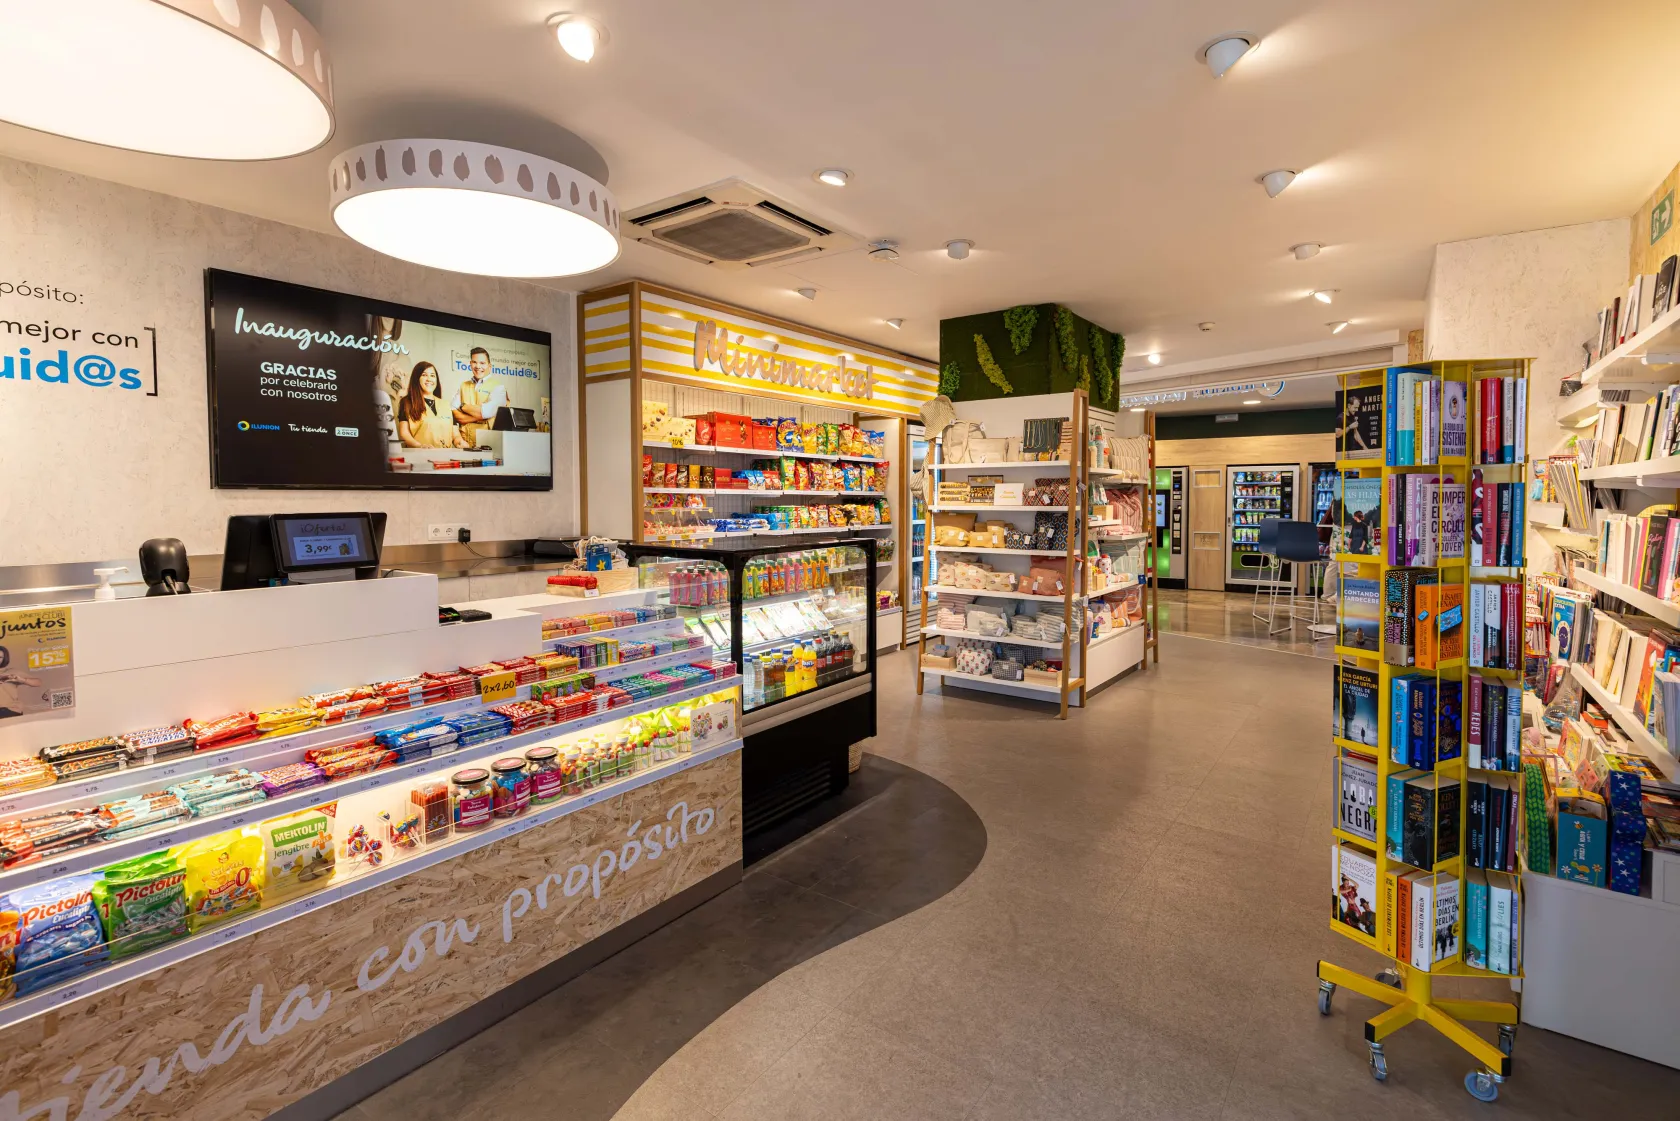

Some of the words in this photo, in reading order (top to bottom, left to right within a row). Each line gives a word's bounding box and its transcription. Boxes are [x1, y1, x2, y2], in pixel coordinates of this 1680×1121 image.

[235, 307, 410, 355] Inauguración
[92, 332, 139, 349] con
[694, 320, 879, 400] Minimarket
[260, 361, 337, 381] GRACIAS
[492, 365, 538, 379] incluid@s
[260, 377, 280, 386] por
[283, 378, 338, 391] celebrarlo
[260, 388, 283, 398] con
[287, 391, 338, 402] nosotros
[251, 419, 280, 431] ILUNION
[302, 425, 328, 433] tienda
[1343, 596, 1379, 604] TARDECERE
[0, 617, 66, 639] juntos
[483, 680, 516, 694] 2x2,60
[1353, 674, 1371, 682] GARCÍA
[1471, 712, 1480, 736] REDES
[1343, 781, 1374, 805] LOBA
[274, 822, 327, 842] MENTOLIN
[357, 919, 480, 991] con
[503, 802, 715, 943] propósito
[22, 891, 94, 928] Pictolin
